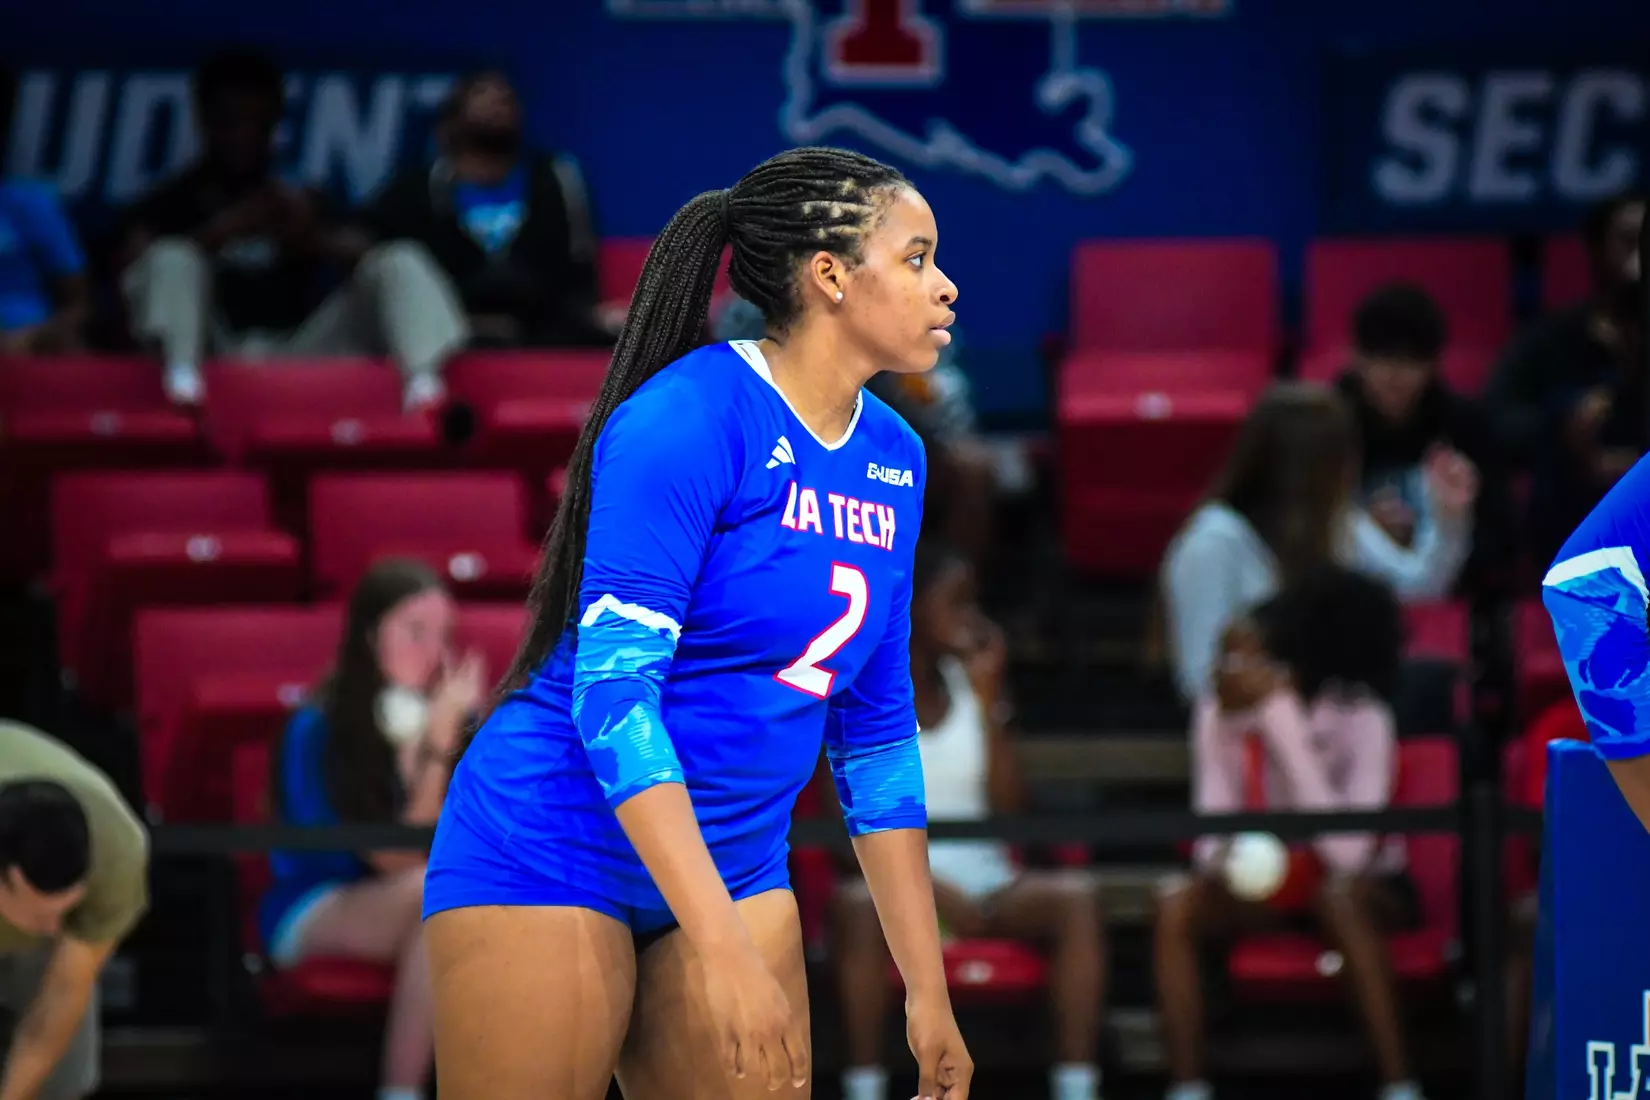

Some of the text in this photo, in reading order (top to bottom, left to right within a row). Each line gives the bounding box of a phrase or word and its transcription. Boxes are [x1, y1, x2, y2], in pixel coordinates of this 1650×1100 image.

[1373, 70, 1645, 203] SEC
[780, 479, 896, 551] LA TECH
[773, 561, 870, 700] 2
